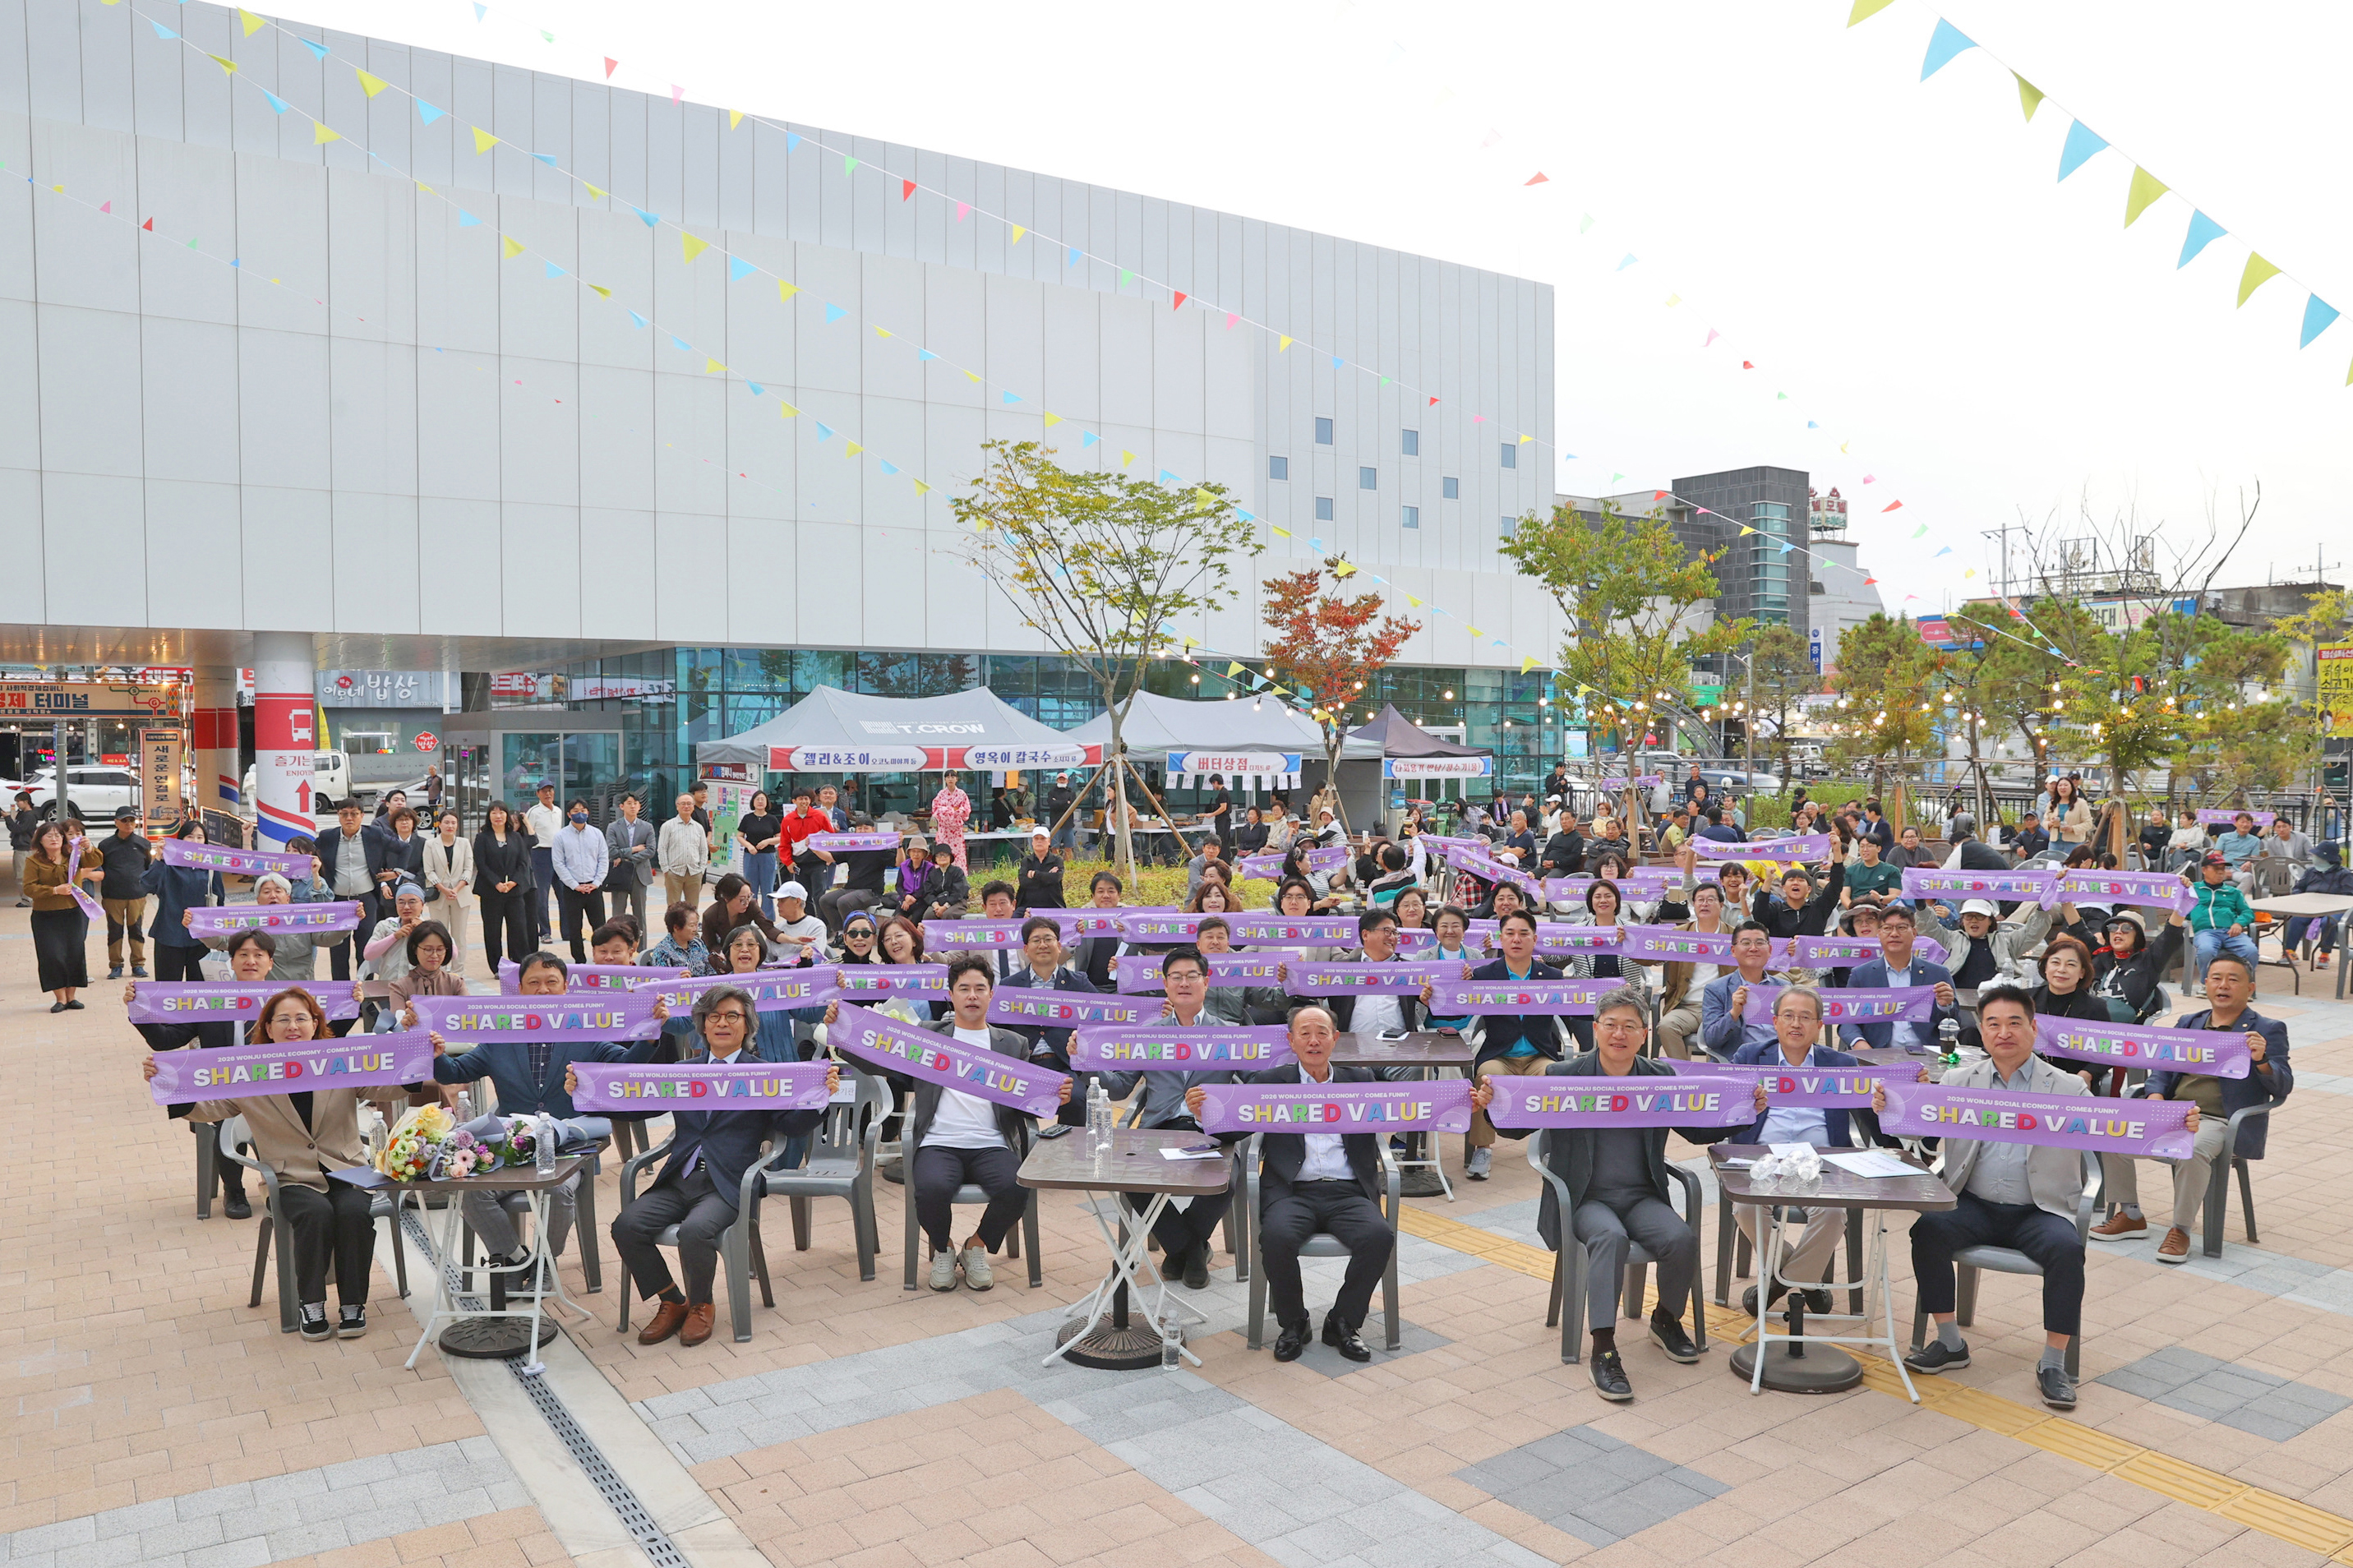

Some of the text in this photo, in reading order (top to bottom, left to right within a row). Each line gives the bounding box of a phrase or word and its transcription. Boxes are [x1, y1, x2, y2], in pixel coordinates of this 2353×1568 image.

[1825, 500, 1846, 513] 모텔
[323, 674, 419, 701] 이모네 밥상
[35, 694, 88, 708] 터미널
[897, 723, 985, 734] T.CROW
[418, 740, 434, 749] 밥상
[154, 745, 169, 772] 새로운
[275, 755, 311, 767] 즐기는
[975, 751, 1010, 763] 영옥이
[1016, 751, 1051, 763] 칼국수
[1197, 758, 1248, 771] 버터상점
[1709, 844, 1811, 853] SHARED VALUE
[183, 851, 290, 873] SHARED VALUE
[1257, 855, 1331, 872] SHAR LUE
[1460, 855, 1497, 875] SHARED
[1920, 879, 2042, 893] SHARED VALUE
[2057, 880, 2178, 898] SHARED VALUE
[214, 913, 335, 929] SHARED VALUE
[1138, 923, 1197, 934] SHARED
[945, 930, 1005, 943] SHARED
[1236, 926, 1352, 938] SHARED VALUE
[1543, 937, 1603, 947] SHARED
[1645, 939, 1709, 953] SHARED
[1809, 947, 1871, 959] SHARED
[1217, 966, 1274, 977] VALUE
[844, 978, 890, 989] ARED
[1307, 974, 1378, 985] SHARED
[666, 983, 811, 1007] SHA VALUE
[1456, 992, 1596, 1005] SHARED VALUE
[163, 996, 252, 1012] SHARED
[999, 1000, 1137, 1022] SHARED VALUE
[1848, 1001, 1907, 1017] VALUE
[445, 1012, 625, 1031] SHARED VALUE
[287, 1049, 321, 1057] ECONOMY
[886, 1026, 1014, 1070] 2026 WONJU SOCIAL ECONOMY COME& FUNNY
[1100, 1043, 1271, 1060] SHARED VALUE
[2057, 1033, 2216, 1063] SHARED VALUE
[193, 1053, 394, 1086] SHARED VALUE
[861, 1029, 1029, 1097] SHARED VALUE
[608, 1078, 793, 1098] SHARED VALUE
[1525, 1094, 1720, 1112] SHARED VALUE
[2023, 1102, 2061, 1110] ECONOMY
[1239, 1102, 1433, 1123] SHARED VALUE
[1920, 1104, 2147, 1139] SHARED VALUE
